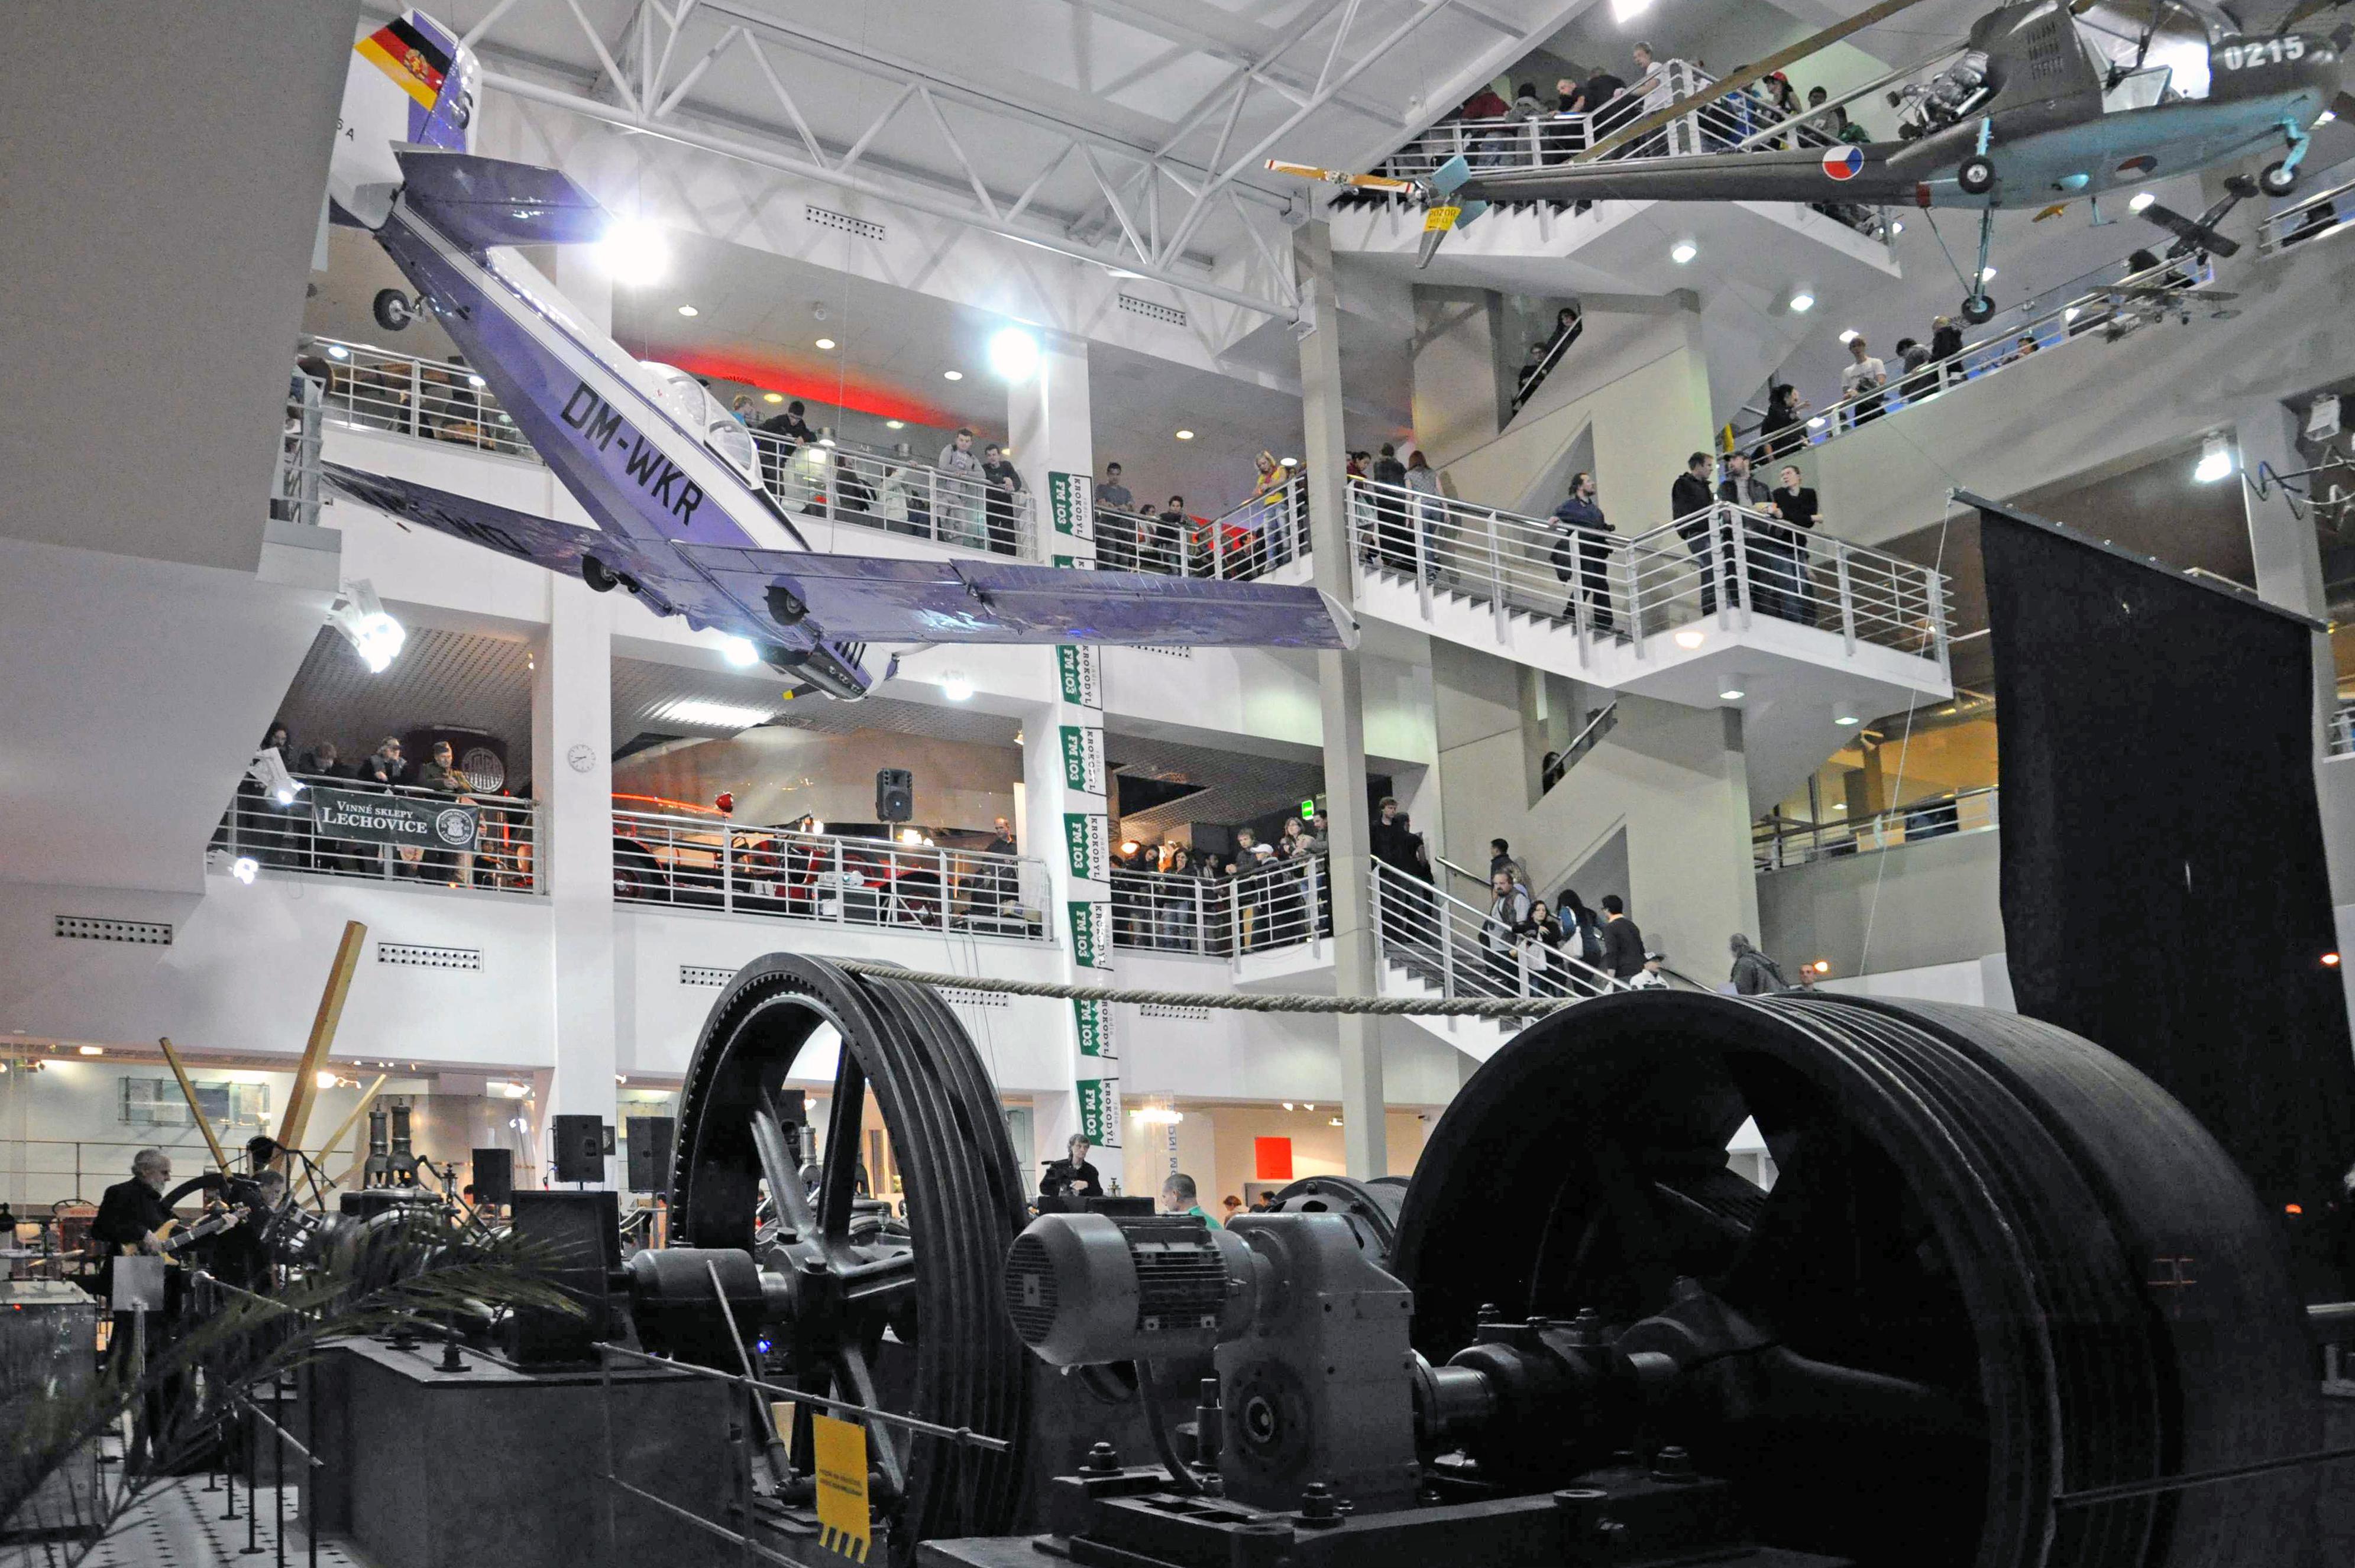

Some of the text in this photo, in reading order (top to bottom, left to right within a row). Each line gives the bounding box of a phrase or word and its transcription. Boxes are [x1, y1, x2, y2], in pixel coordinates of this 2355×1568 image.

[2224, 35, 2304, 70] 0215
[561, 381, 703, 526] DM-WKR
[1056, 480, 1067, 525] FM 103
[1064, 649, 1075, 695] FM 103
[1068, 734, 1079, 781] FM 103
[322, 806, 428, 834] LECHOVICE
[337, 801, 413, 819] VINNÉ SKLEPY
[1072, 822, 1083, 869] FM 103
[1091, 818, 1101, 877] KROKODÝL
[1076, 911, 1088, 957] FM 103
[1081, 999, 1092, 1047] FM 103
[1085, 1089, 1096, 1136] FM 103
[1105, 1083, 1115, 1143] KROKODÝL
